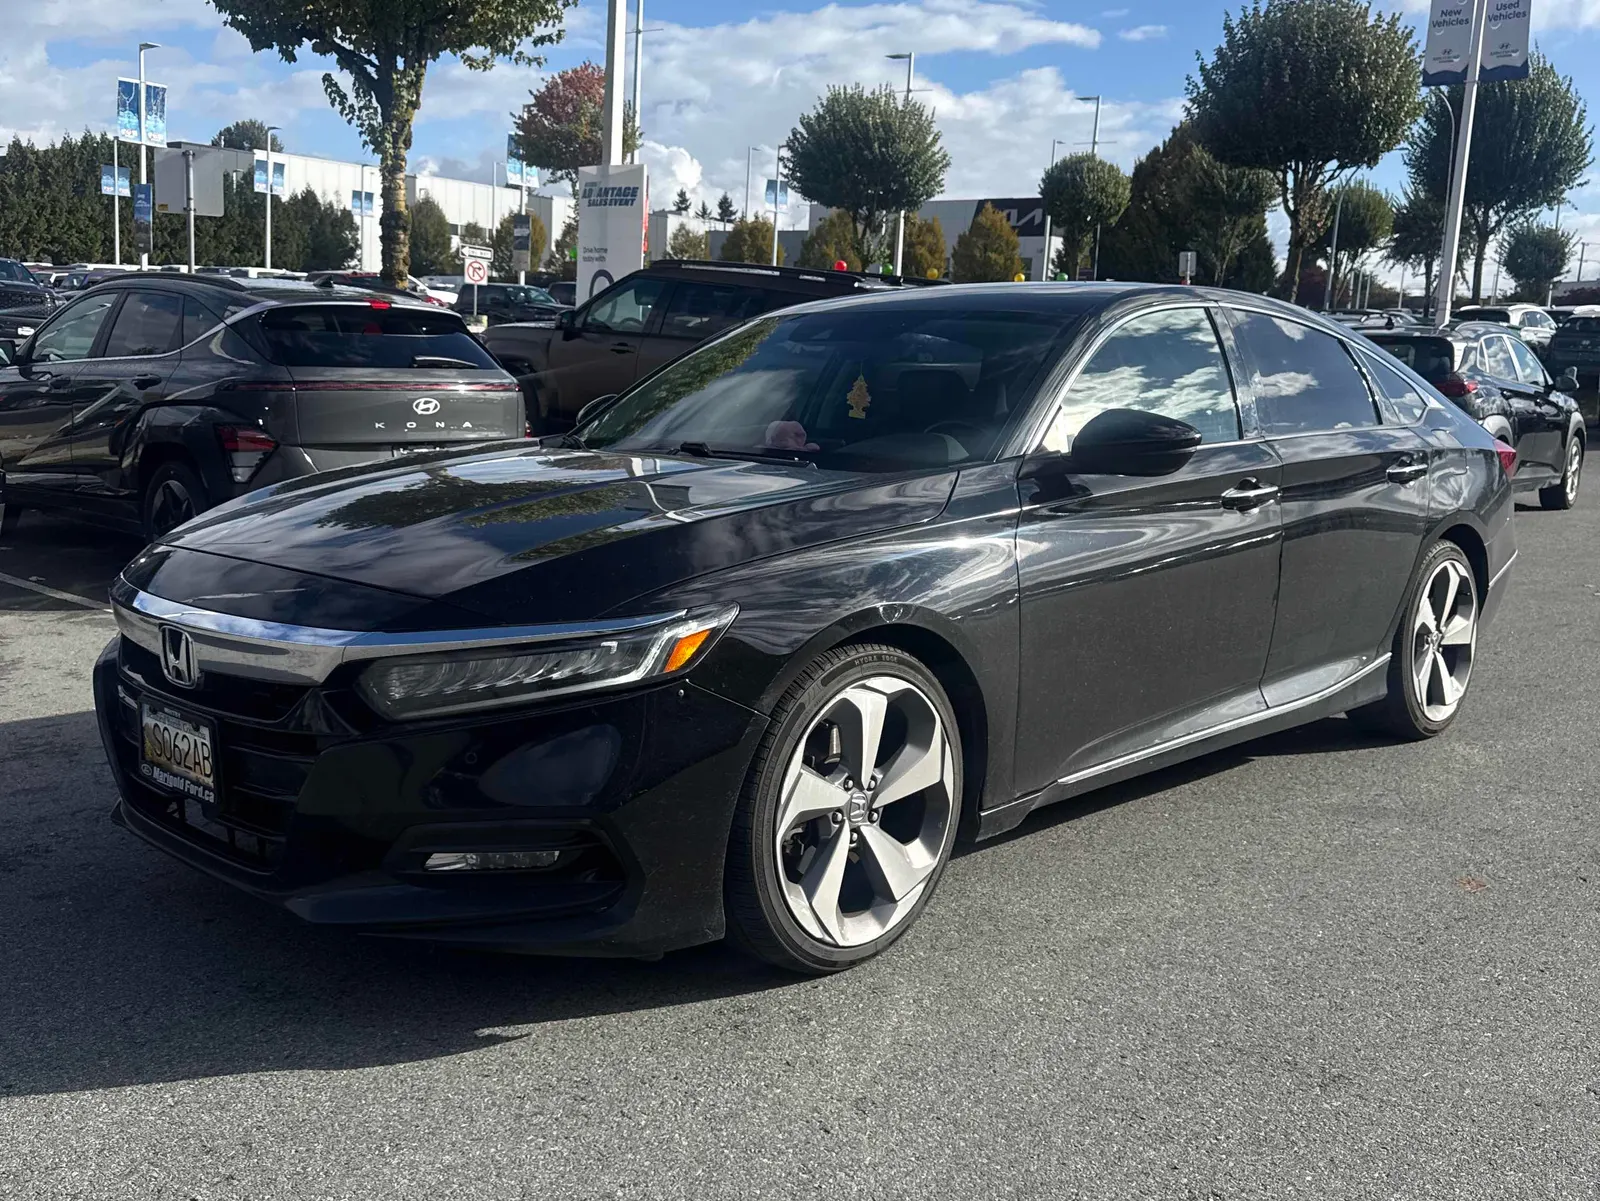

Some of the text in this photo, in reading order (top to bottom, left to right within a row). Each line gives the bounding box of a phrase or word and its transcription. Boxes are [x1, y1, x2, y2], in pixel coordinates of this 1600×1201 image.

[1495, 1, 1520, 11] Used
[1440, 9, 1463, 18] New
[1488, 9, 1527, 22] Vehicles
[1432, 17, 1470, 28] Vehicles
[582, 186, 639, 199] ADANTAGE
[587, 198, 636, 207] SALES EVENT
[375, 421, 473, 429] KONA
[152, 765, 185, 790] Marigold
[184, 779, 215, 803] Ford.ca
